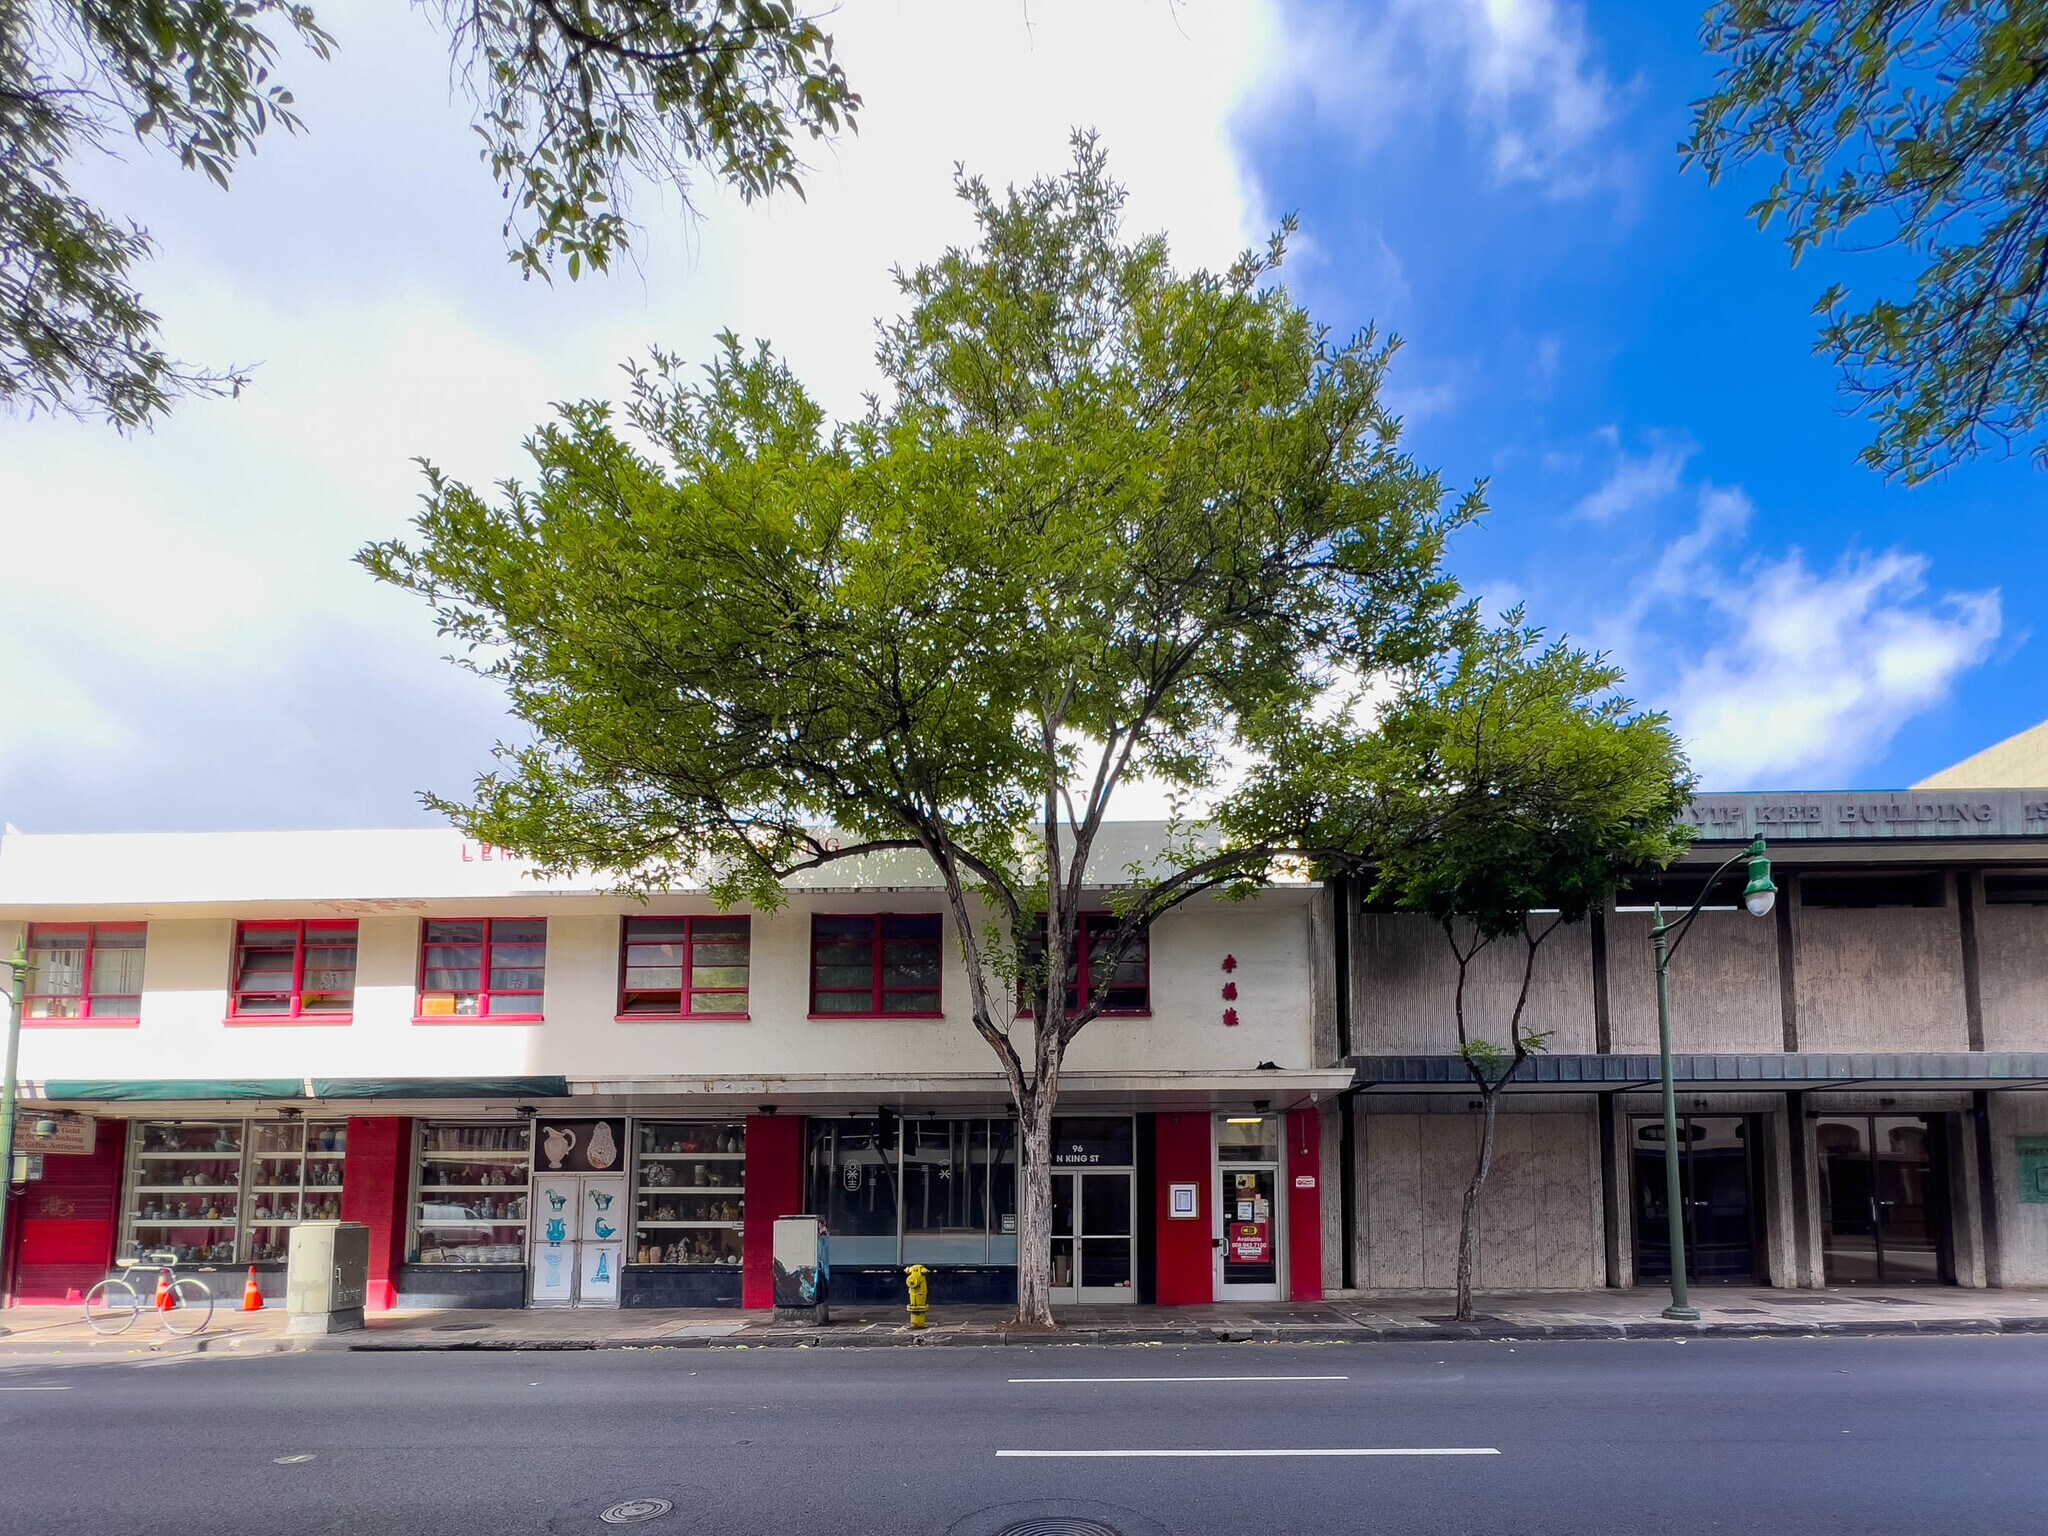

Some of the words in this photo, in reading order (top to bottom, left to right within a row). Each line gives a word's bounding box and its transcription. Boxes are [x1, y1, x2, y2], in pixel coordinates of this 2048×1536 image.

[1755, 805, 1822, 825] KEE
[1838, 803, 1993, 824] BUILDING
[1072, 1144, 1084, 1153] 96
[1056, 1154, 1063, 1163] N
[1065, 1154, 1088, 1163] KING
[1089, 1154, 1100, 1163] ST
